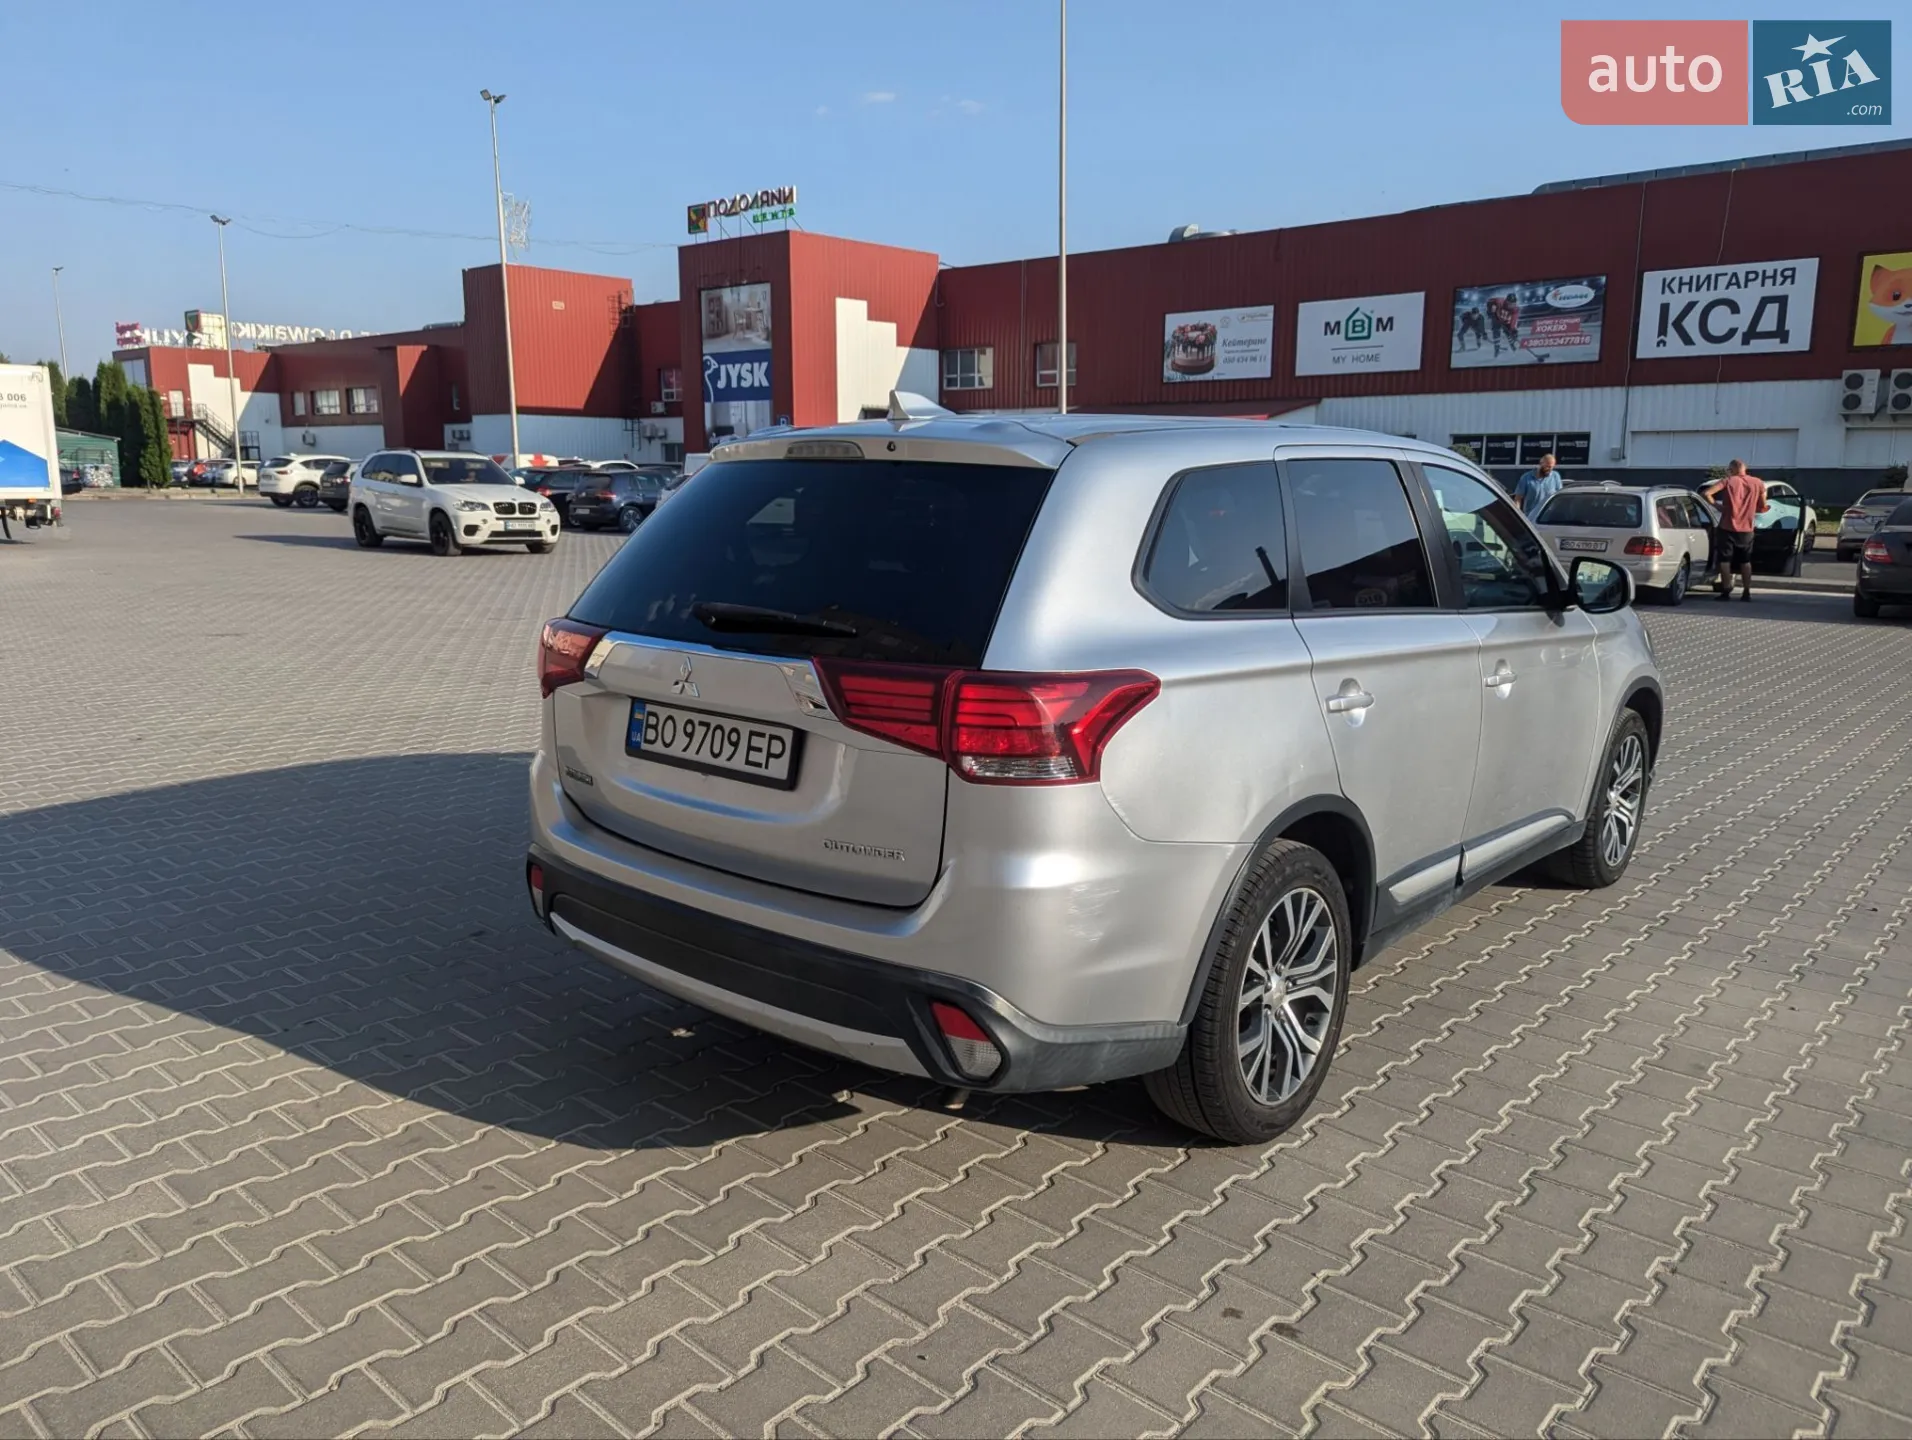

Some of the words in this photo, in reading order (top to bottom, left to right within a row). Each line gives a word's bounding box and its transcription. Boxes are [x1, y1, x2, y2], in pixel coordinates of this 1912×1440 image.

[1661, 267, 1797, 295] КНИГАРНЯ
[1535, 324, 1567, 333] ХОКЕЮ
[1656, 295, 1790, 348] КСД
[1331, 354, 1347, 365] MY
[1351, 353, 1381, 364] HOME
[717, 361, 770, 389] JYSK
[631, 731, 642, 743] UA
[643, 711, 677, 749] BO
[681, 718, 741, 762] 9709
[744, 730, 786, 770] EP
[824, 838, 905, 861] OUTLANDER
